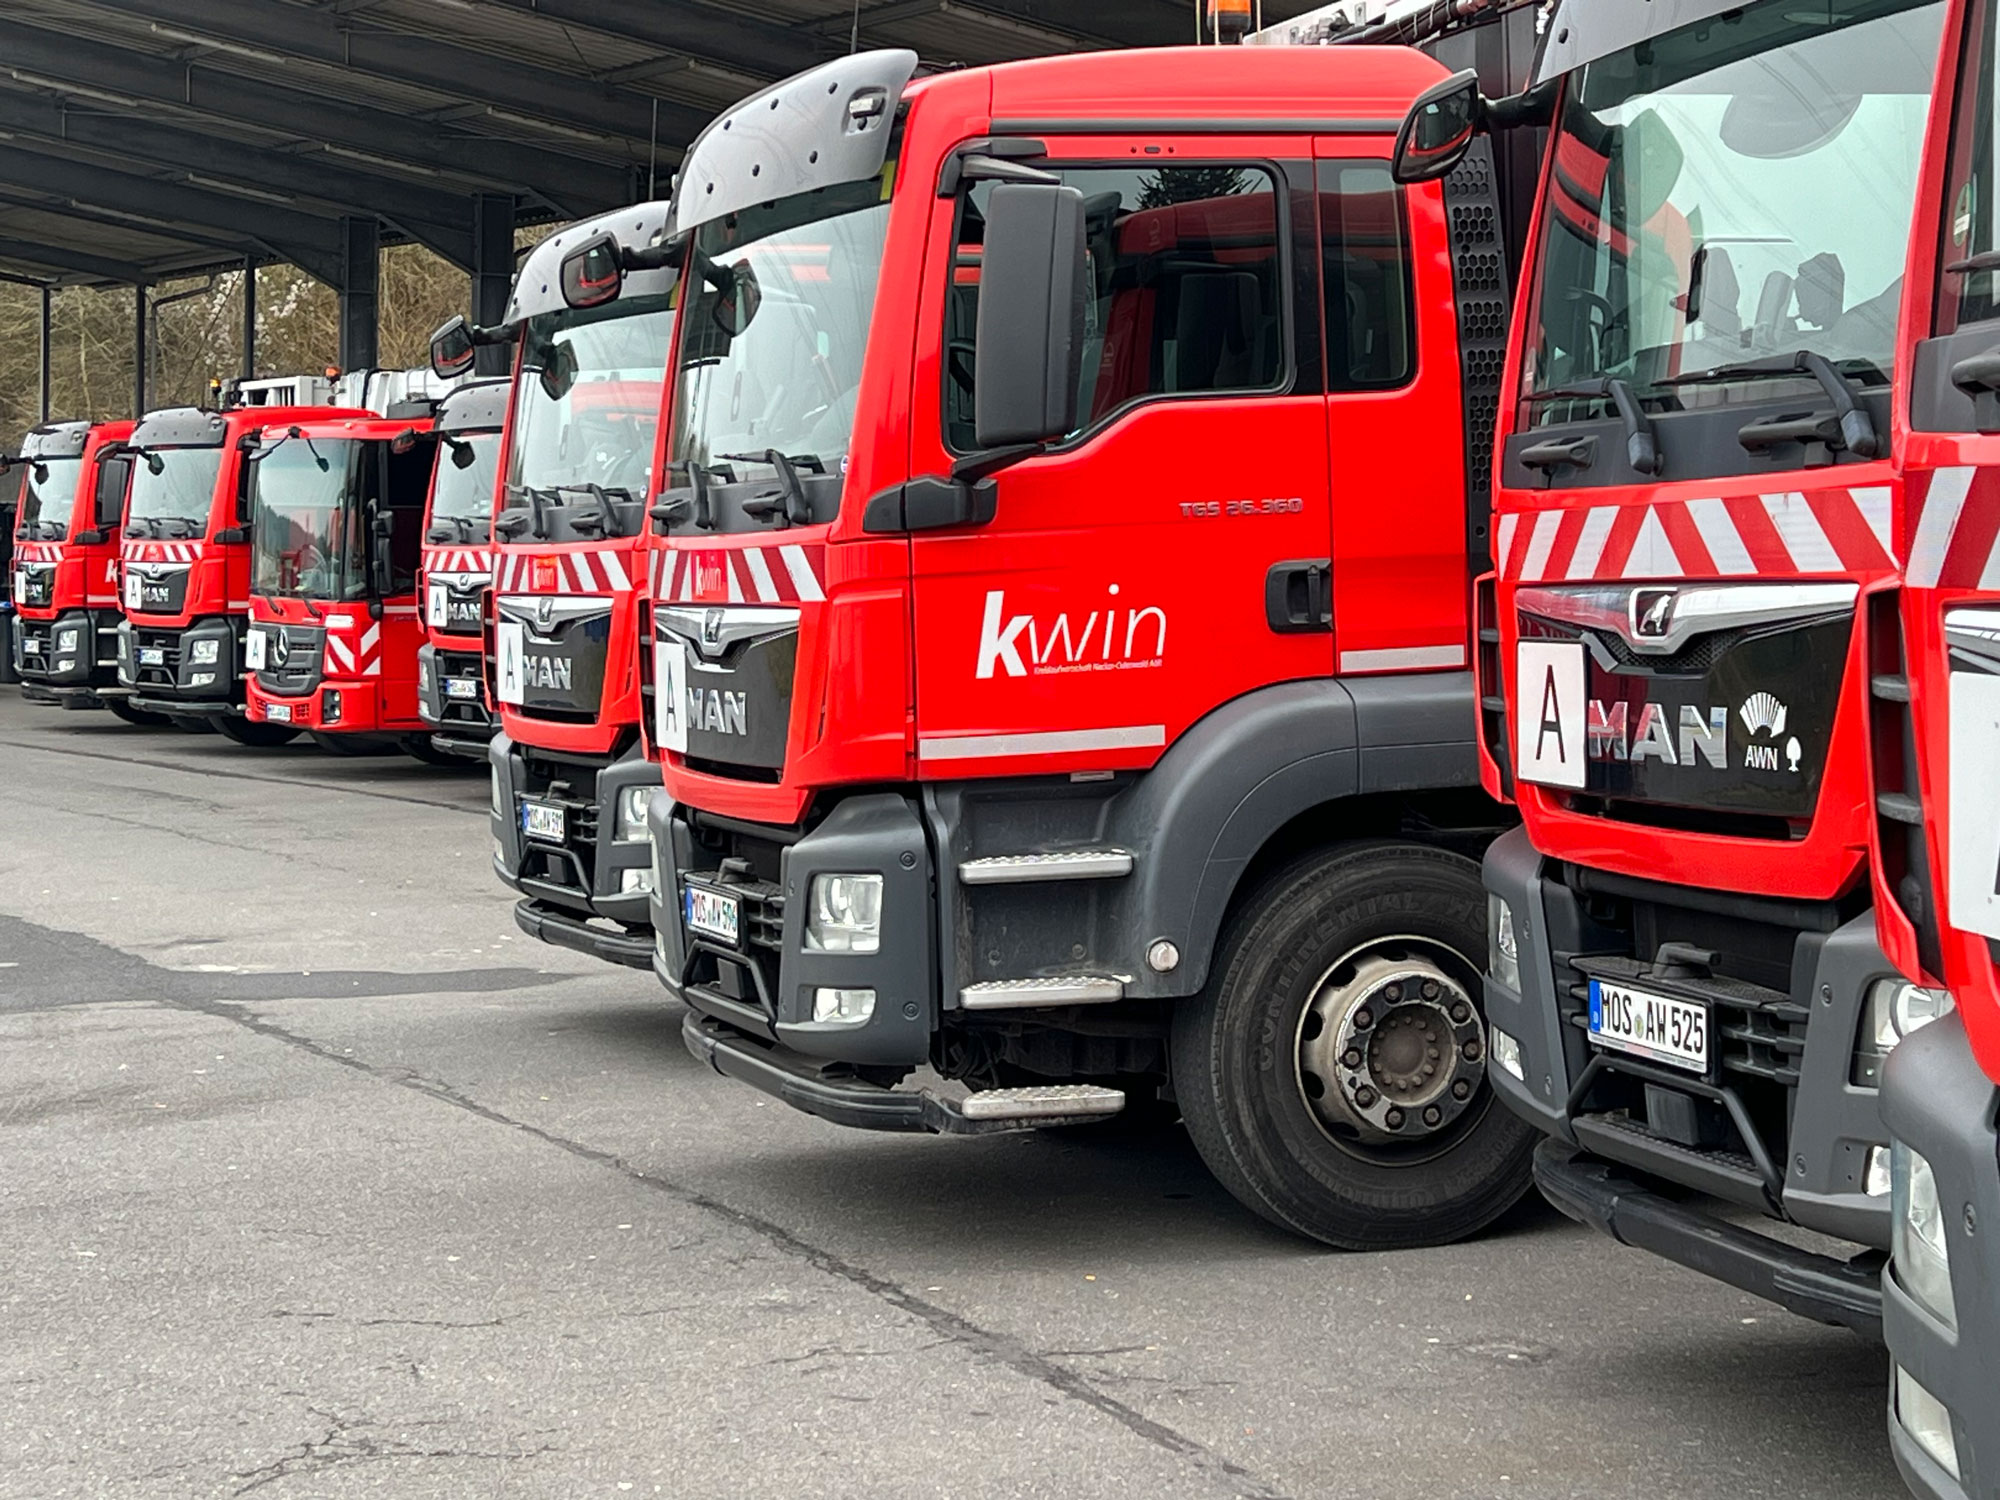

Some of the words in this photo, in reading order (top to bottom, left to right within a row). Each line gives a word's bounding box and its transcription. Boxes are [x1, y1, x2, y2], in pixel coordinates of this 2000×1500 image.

[1179, 501, 1220, 517] TGS
[1226, 497, 1303, 515] 26.360
[433, 591, 443, 620] A
[447, 602, 481, 621] MAN
[975, 583, 1167, 679] kwin
[505, 635, 516, 691] A
[523, 654, 572, 690] MAN
[665, 660, 678, 734] A
[687, 686, 747, 736] MAN
[1535, 663, 1566, 764] A
[1588, 699, 1729, 769] MAN
[1744, 744, 1779, 772] AWN
[1600, 987, 1633, 1036] MOS
[1645, 1000, 1667, 1046] AW
[1671, 1005, 1704, 1055] 525
